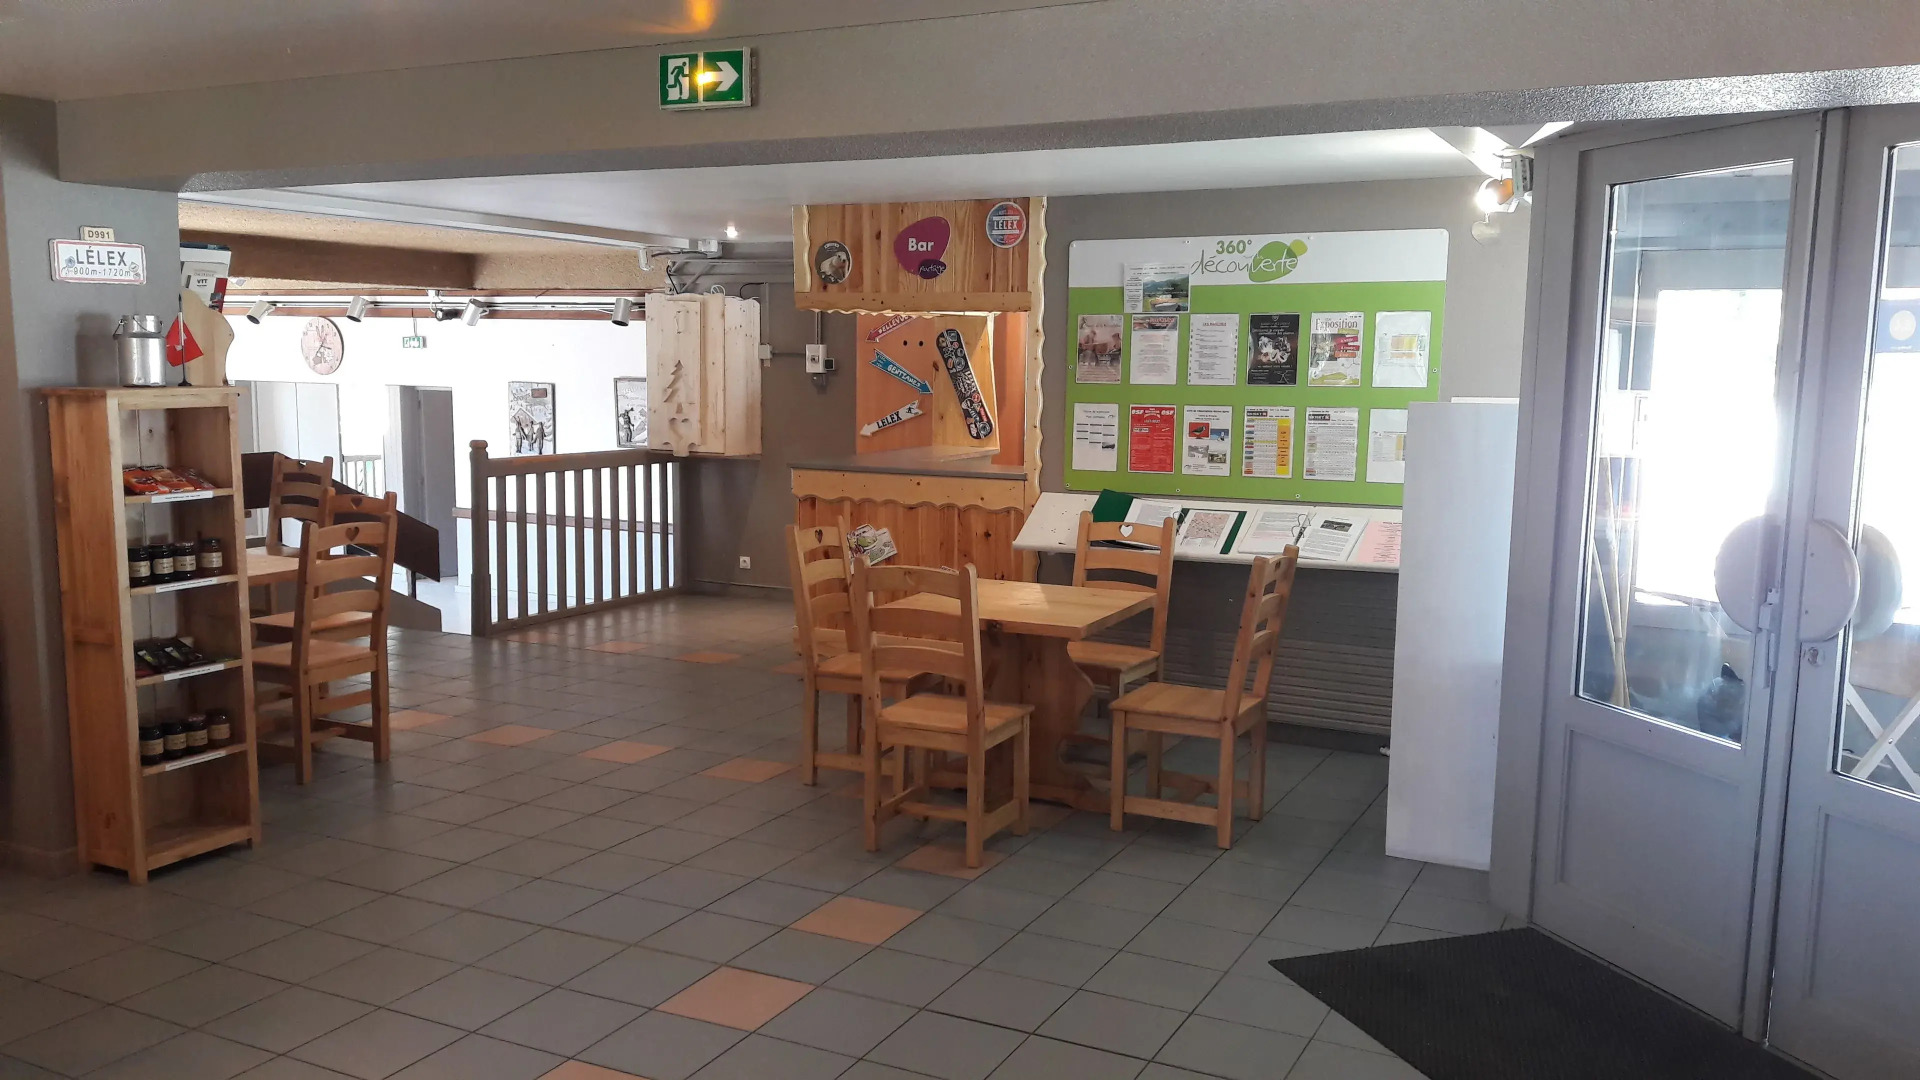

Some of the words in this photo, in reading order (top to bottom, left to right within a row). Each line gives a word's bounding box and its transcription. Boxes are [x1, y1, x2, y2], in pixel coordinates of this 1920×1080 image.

[994, 219, 1018, 230] LÉLEX
[87, 230, 111, 239] D991
[908, 237, 935, 252] Bar
[1215, 239, 1253, 255] 360°
[75, 245, 127, 267] LÉLEX
[876, 410, 903, 430] LELEX
